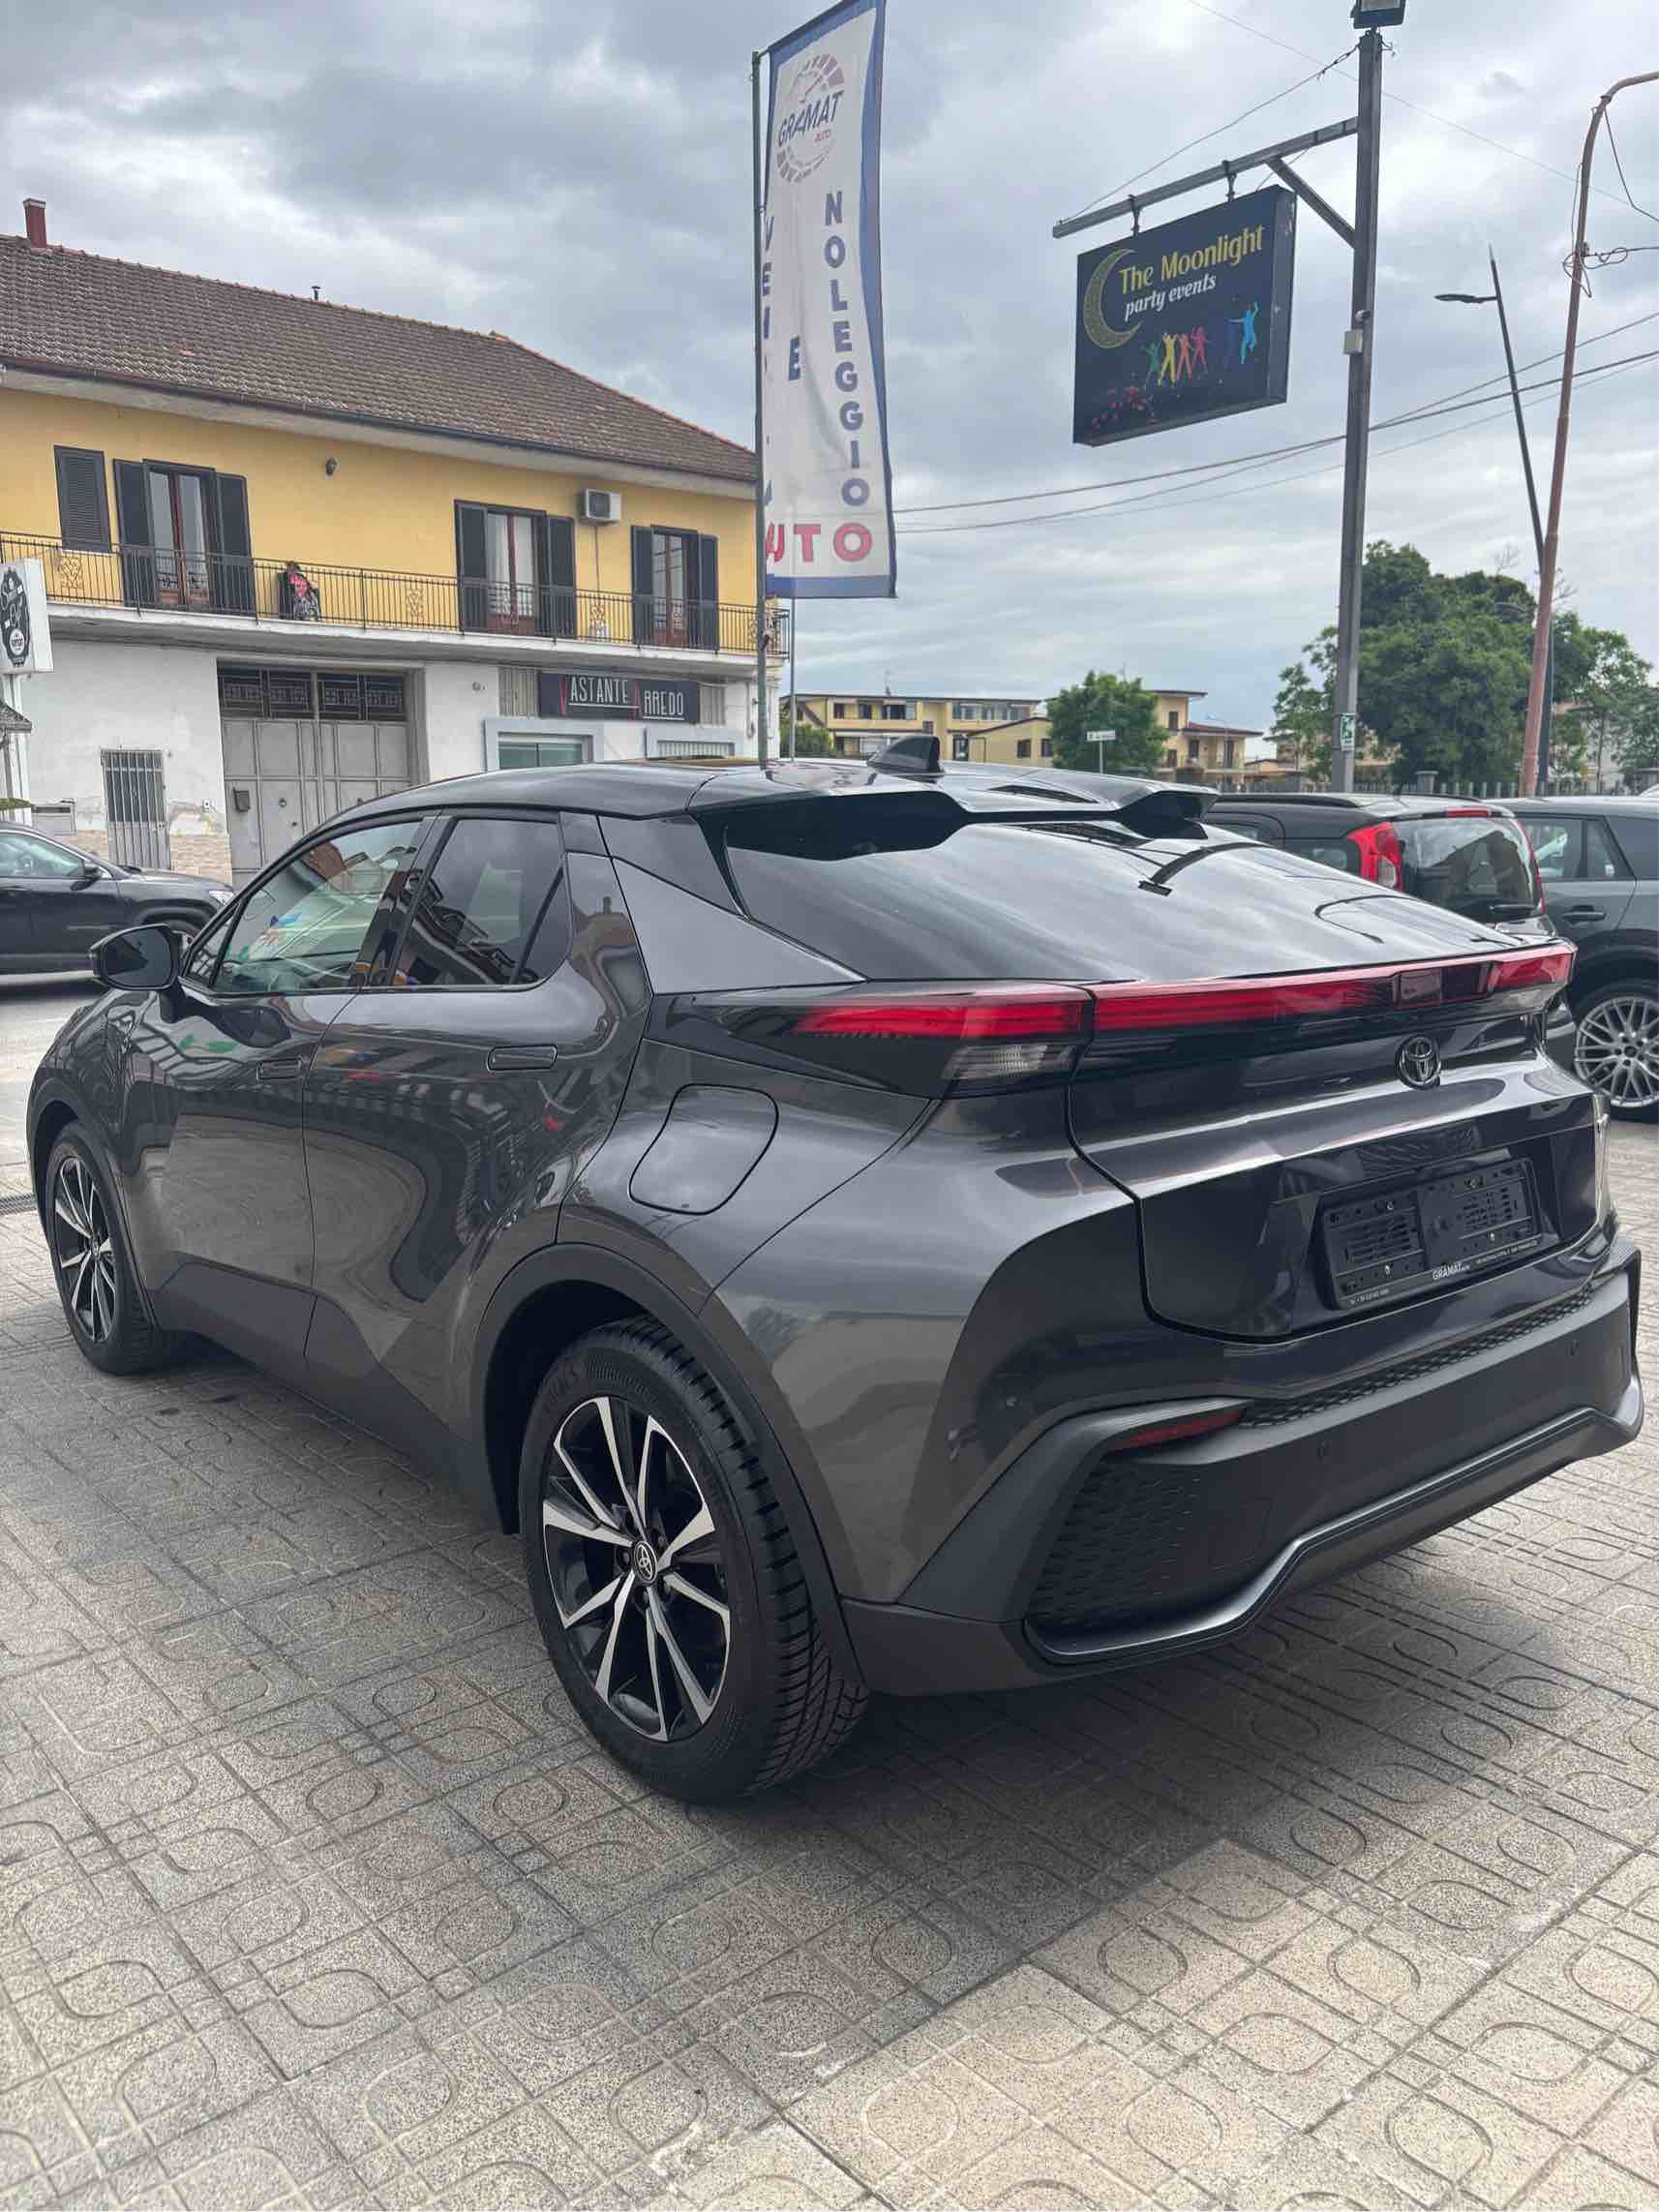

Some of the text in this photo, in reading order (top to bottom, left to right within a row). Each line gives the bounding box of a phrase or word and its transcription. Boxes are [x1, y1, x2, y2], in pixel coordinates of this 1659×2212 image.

[1118, 225, 1265, 294] The Moonlight
[1124, 273, 1217, 321] party events
[825, 191, 870, 506] NOLEGGIO
